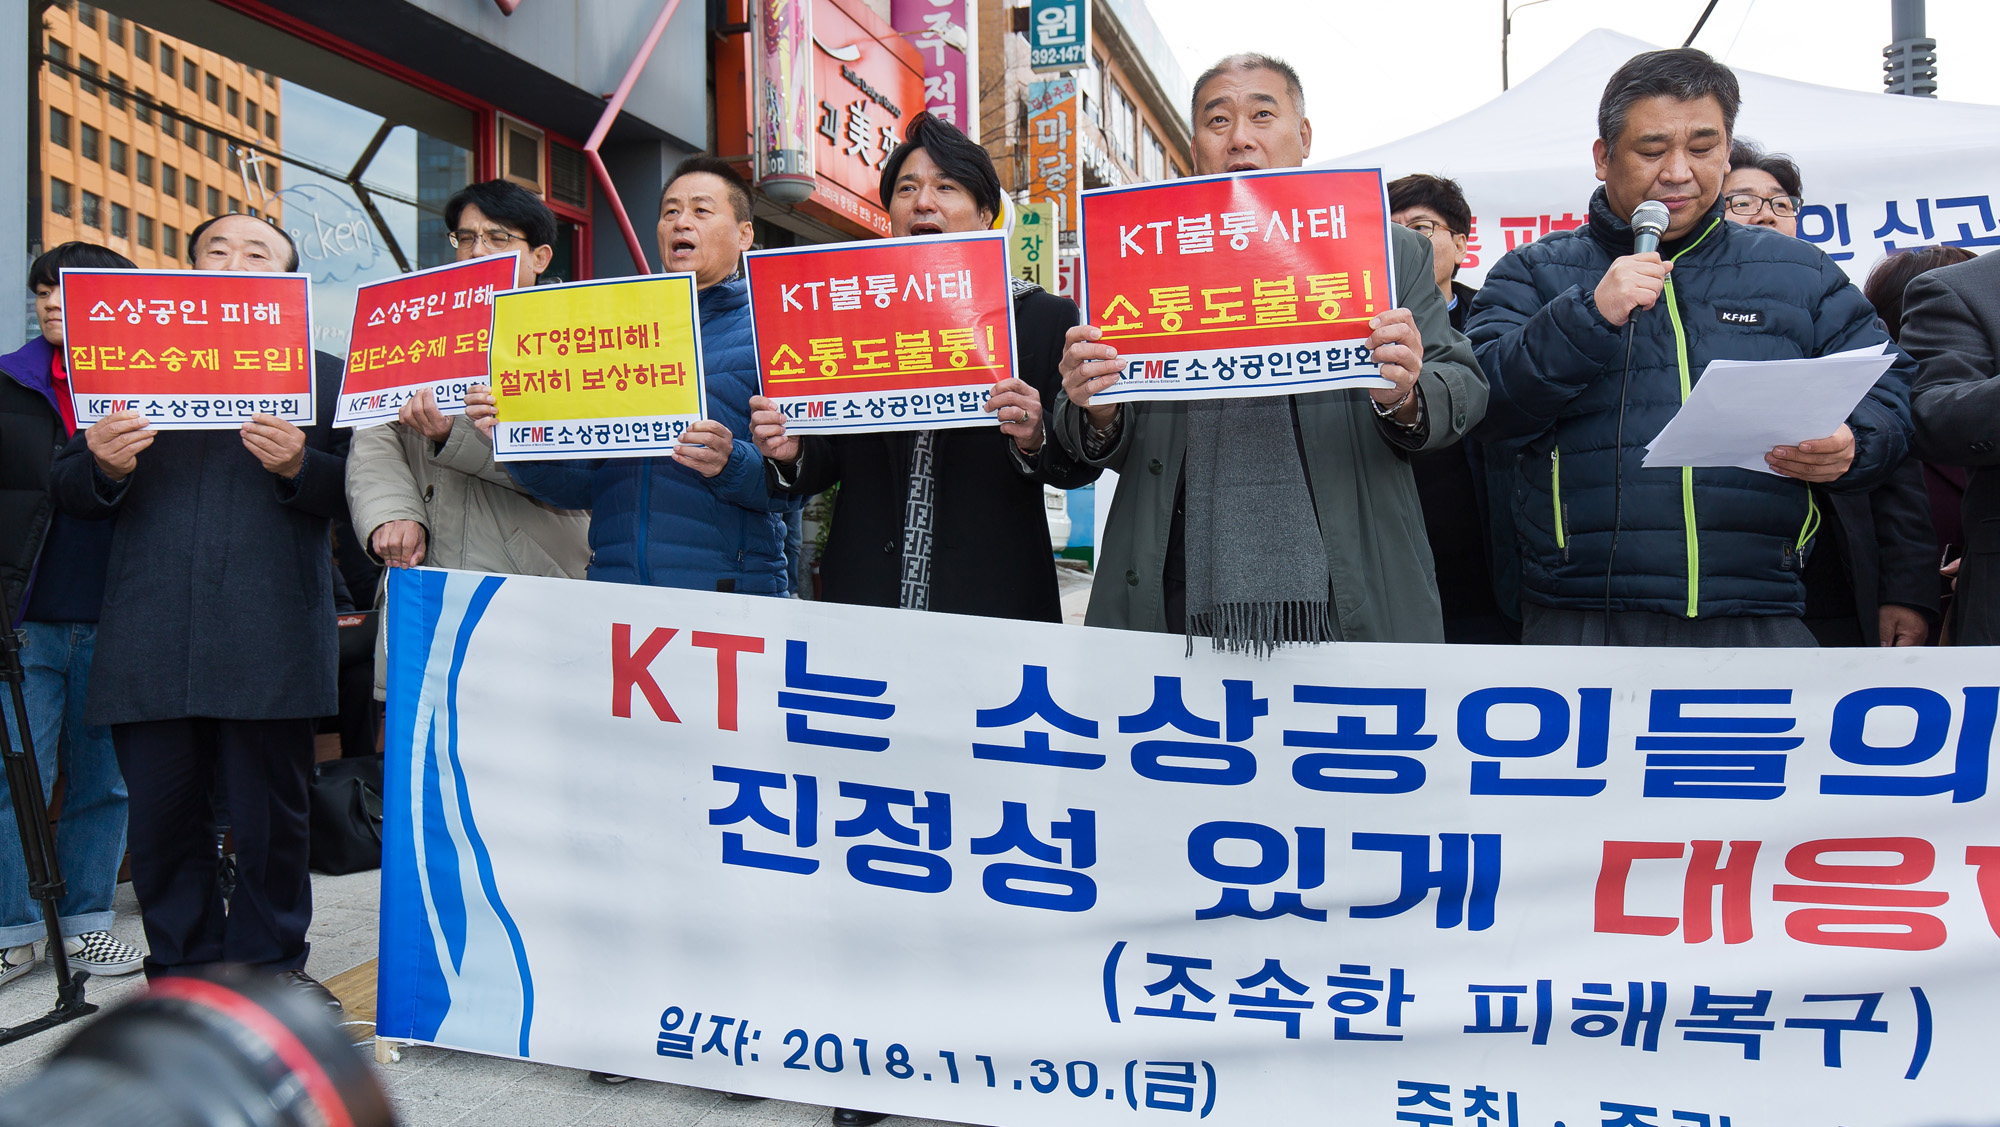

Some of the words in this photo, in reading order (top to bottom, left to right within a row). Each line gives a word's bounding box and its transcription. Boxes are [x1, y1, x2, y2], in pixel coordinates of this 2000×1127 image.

[1119, 204, 1347, 258] KT불통사태
[367, 291, 447, 327] 소상공인
[452, 284, 494, 310] 피해
[781, 269, 973, 312] KT불통사태
[1100, 270, 1373, 332] 소통도불통!
[88, 298, 208, 325] 소상공인
[221, 302, 281, 325] 피해
[1722, 312, 1757, 322] KFME
[350, 336, 447, 373] 집단소송제
[516, 321, 660, 356] KT영업피해!
[769, 326, 996, 377] 소통도불통!
[71, 345, 220, 372] 집단소송제
[233, 347, 304, 371] 도입!
[1185, 347, 1379, 380] 소상공인연합회
[500, 368, 571, 397] 철저히
[582, 362, 686, 391] 보상하라
[145, 398, 299, 417] 소상공인연합회
[349, 393, 389, 412] KFME
[780, 400, 837, 419] KFME
[510, 426, 553, 443] KFME
[611, 623, 896, 752] KT는
[972, 664, 2000, 804] 소상공인들의
[708, 765, 1097, 913] 진정성
[1187, 821, 1501, 932] 있게
[1102, 941, 1415, 1042] (조속한
[1463, 978, 1933, 1081] 피해복구)
[656, 1005, 761, 1066] 일자:
